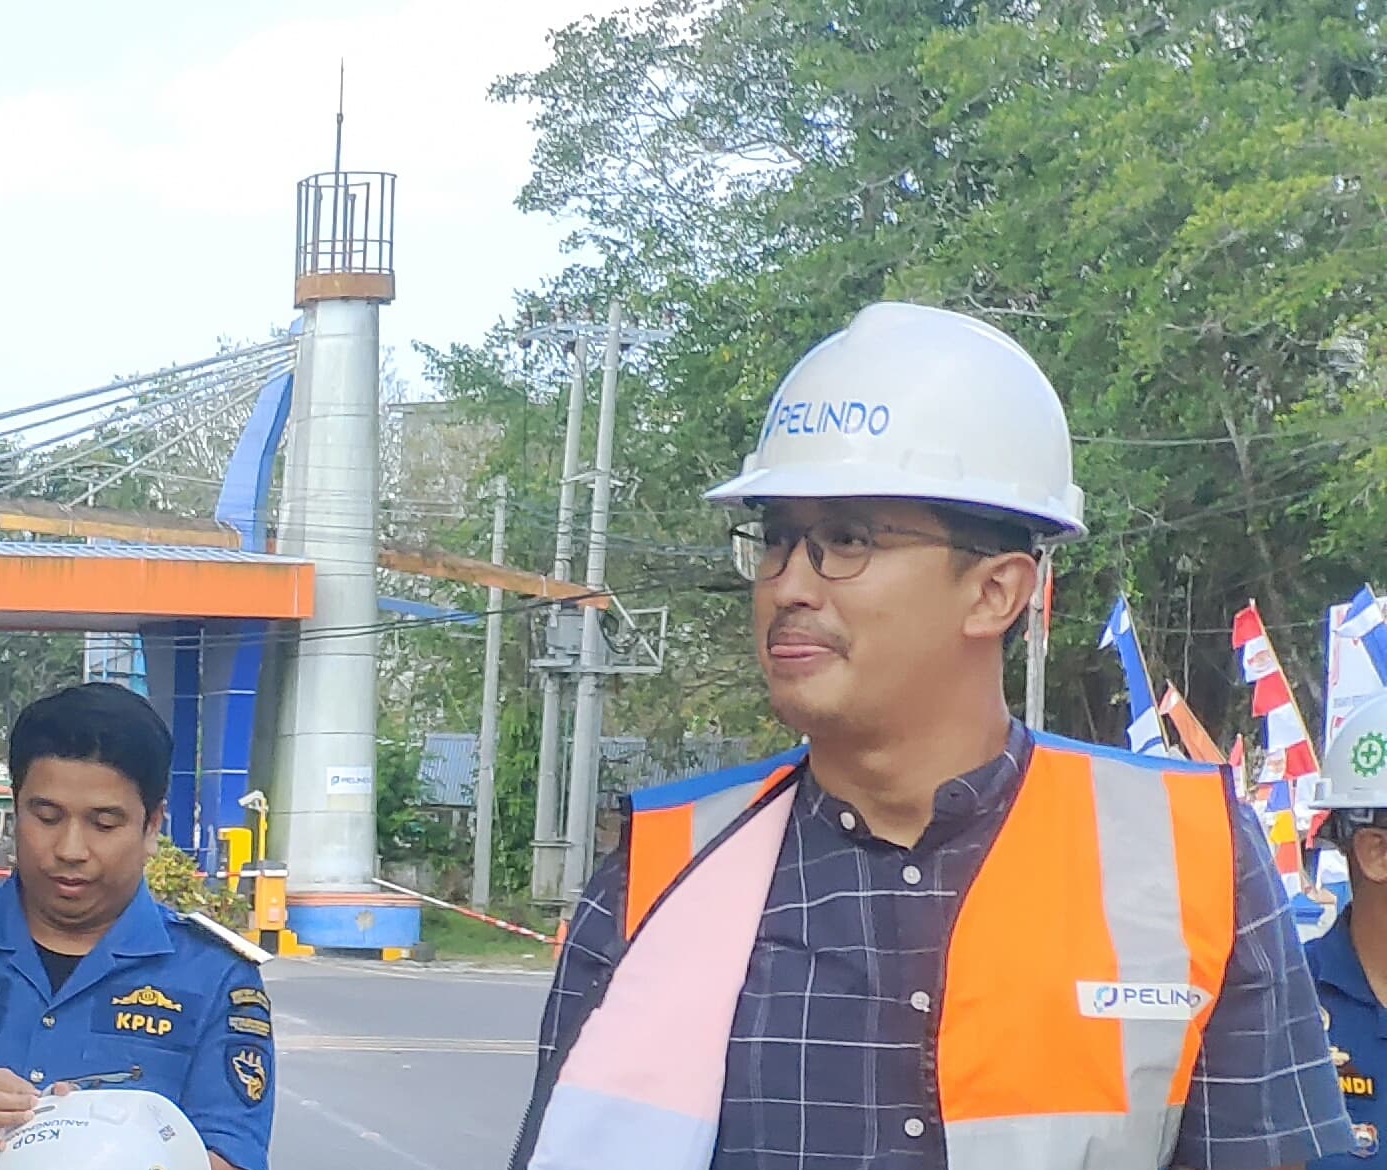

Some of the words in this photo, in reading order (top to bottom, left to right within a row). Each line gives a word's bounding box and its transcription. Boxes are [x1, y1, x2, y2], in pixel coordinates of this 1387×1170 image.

[774, 401, 890, 436] PELINDO
[116, 1012, 172, 1035] KPLP
[12, 1128, 60, 1150] KSOP
